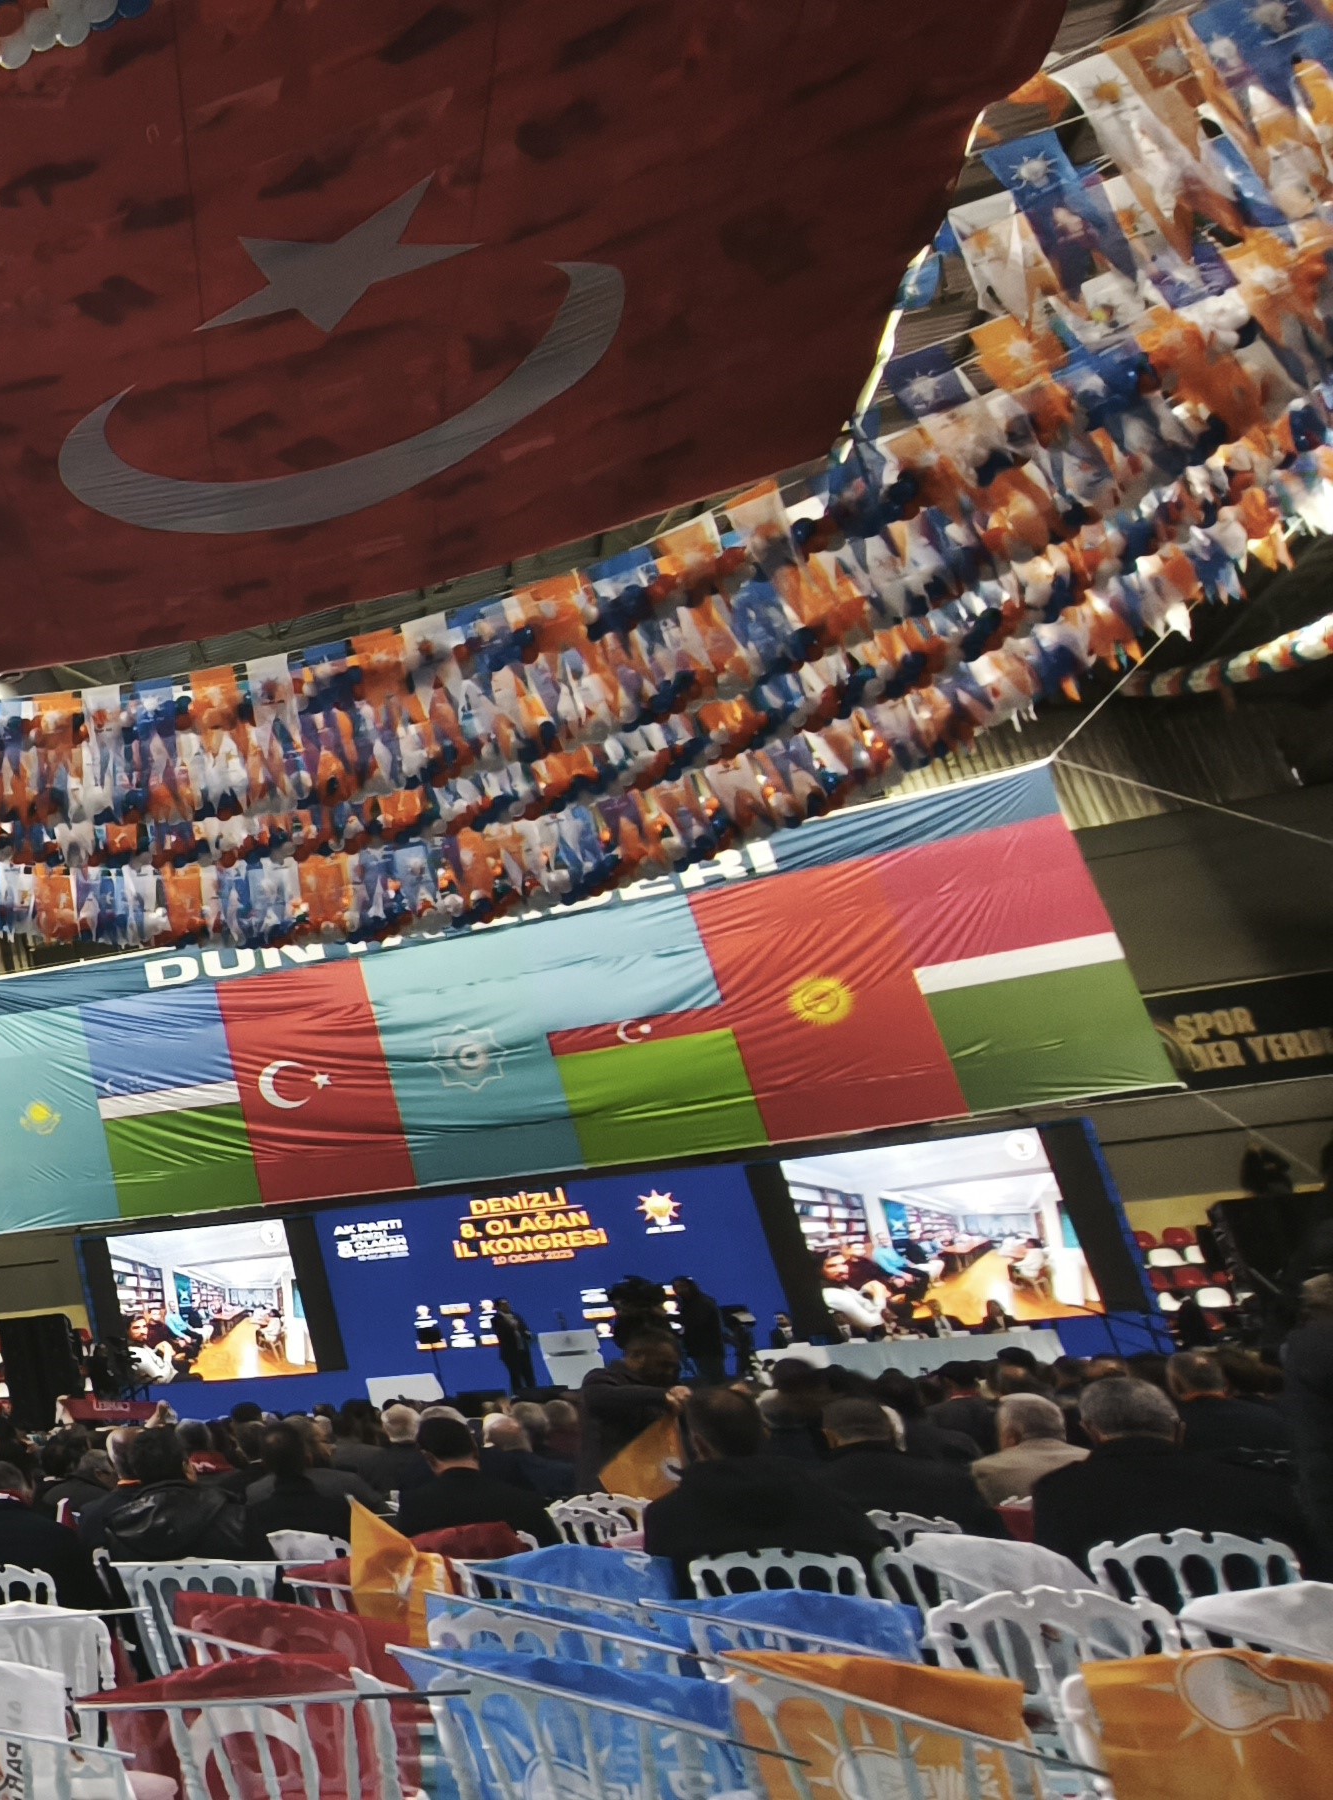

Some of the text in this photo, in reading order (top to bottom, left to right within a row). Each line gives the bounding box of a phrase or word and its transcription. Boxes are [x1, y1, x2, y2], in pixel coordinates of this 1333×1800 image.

[1174, 1006, 1257, 1040] SPOR
[469, 1186, 567, 1216] DENİZLİ
[459, 1210, 591, 1239] 8. OLAĞAN
[452, 1228, 609, 1259] İL KONGRESİ
[508, 1251, 542, 1265] OCAK
